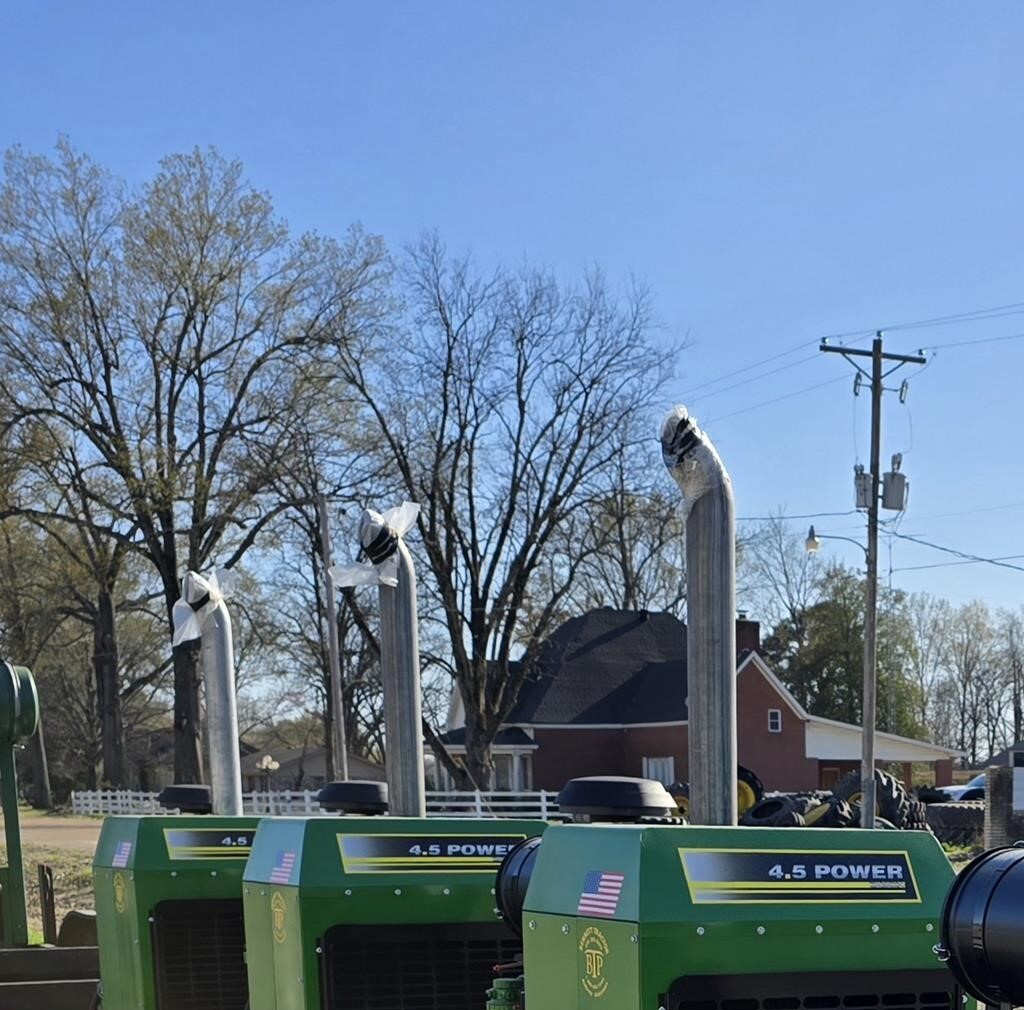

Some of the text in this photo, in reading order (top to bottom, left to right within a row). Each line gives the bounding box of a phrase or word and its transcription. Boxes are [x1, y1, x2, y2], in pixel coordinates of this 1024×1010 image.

[221, 836, 248, 846] 4.5
[409, 844, 441, 856] 4.5
[768, 864, 904, 880] 4.5 POWER
